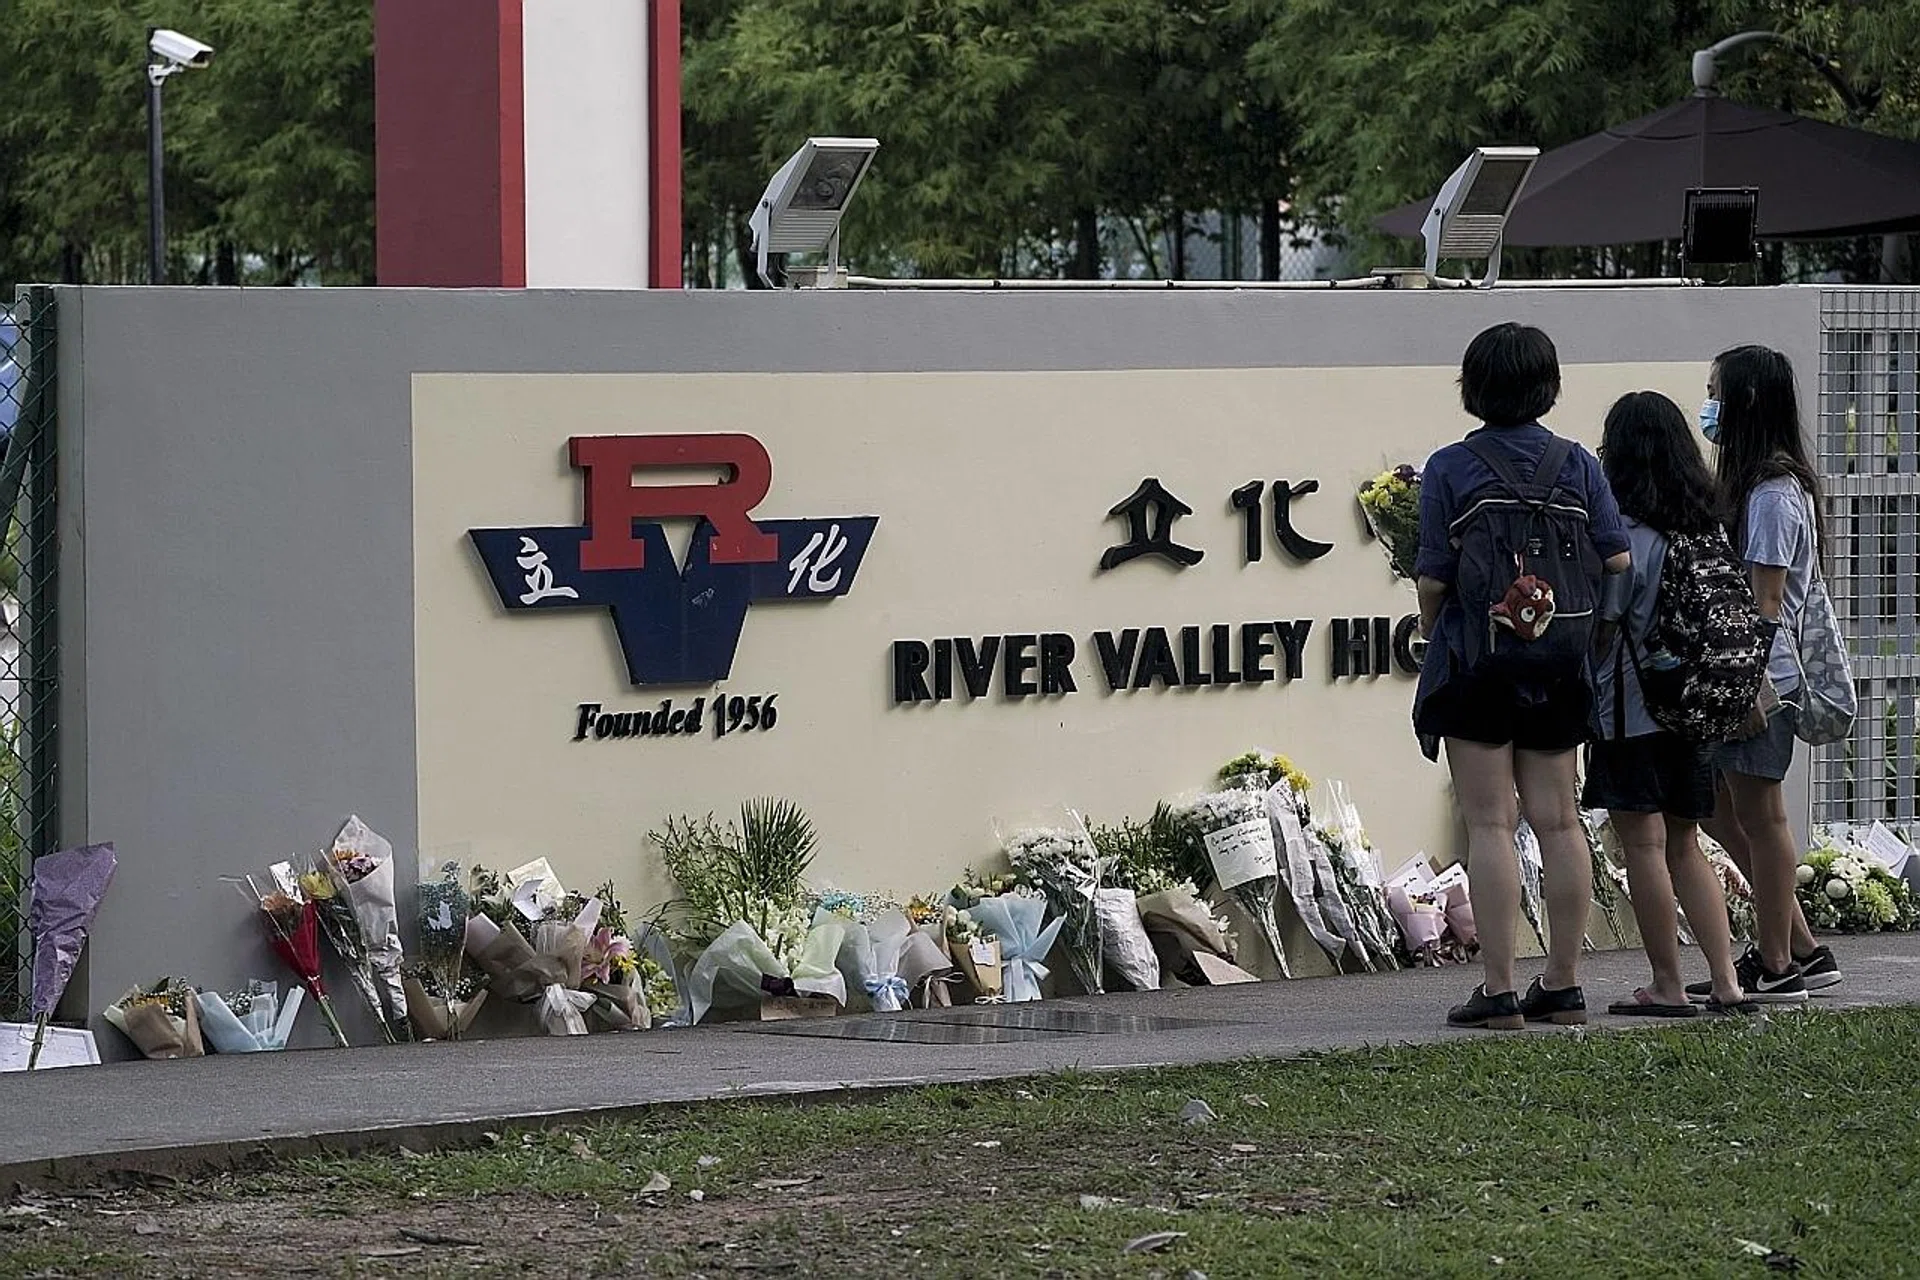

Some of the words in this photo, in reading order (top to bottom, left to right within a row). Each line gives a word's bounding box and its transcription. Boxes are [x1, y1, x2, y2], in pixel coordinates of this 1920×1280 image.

[787, 523, 848, 594] 化
[1100, 476, 1376, 571] 立化
[516, 535, 579, 606] 立
[893, 632, 1077, 702] RIVER
[1094, 619, 1313, 691] VALLEY
[571, 697, 706, 740] Founded
[713, 693, 779, 737] 1956
